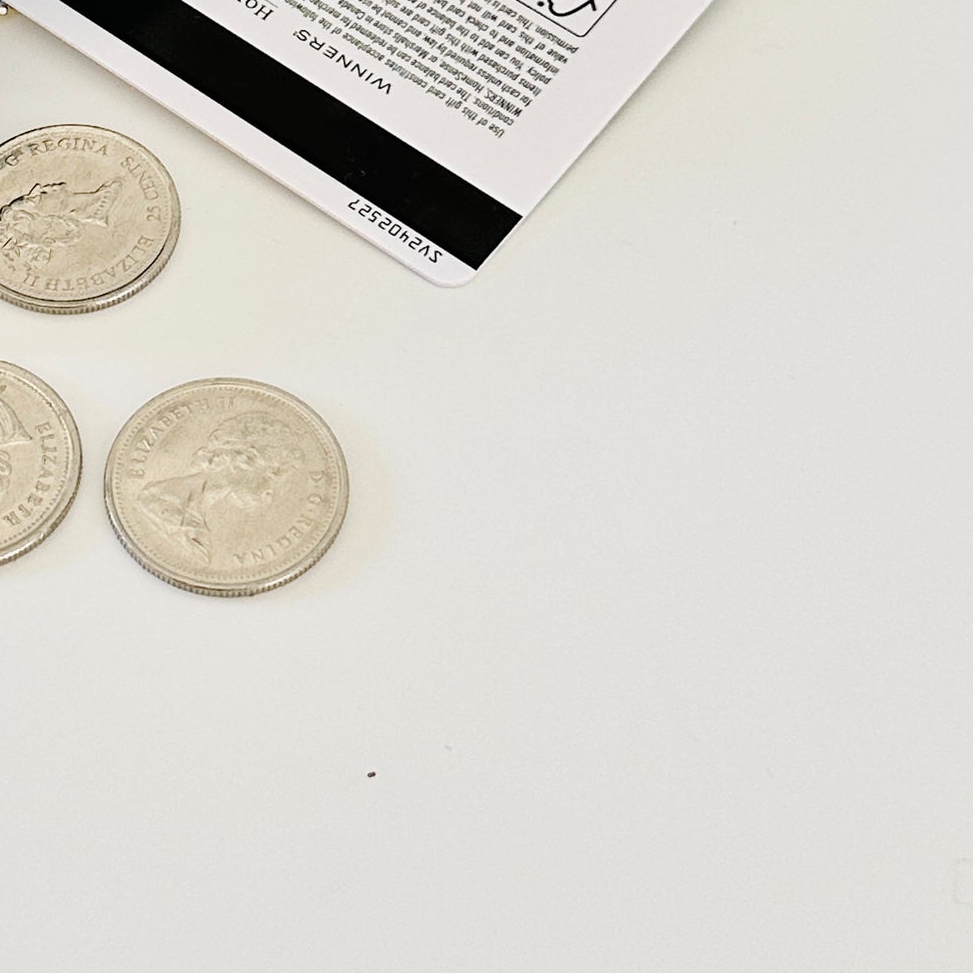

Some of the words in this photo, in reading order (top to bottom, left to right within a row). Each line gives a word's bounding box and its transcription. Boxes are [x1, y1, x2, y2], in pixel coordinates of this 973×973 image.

[370, 3, 384, 16] be
[398, 5, 415, 17] are
[414, 0, 428, 10] of
[445, 4, 467, 18] card
[466, 0, 484, 13] not
[490, 0, 502, 10] is
[496, 3, 519, 19] card
[317, 17, 333, 31] the
[339, 15, 353, 28] for
[364, 14, 375, 25] in
[380, 9, 409, 29] cannot
[410, 13, 432, 28] card
[425, 6, 458, 30] balance
[464, 15, 490, 32] check
[480, 9, 499, 23] will
[515, 14, 535, 31] This
[329, 26, 343, 35] of
[348, 21, 389, 48] redeemed
[372, 19, 395, 36] store
[403, 24, 423, 38] and
[428, 23, 448, 37] gift
[455, 24, 471, 38] the
[488, 28, 500, 40] to
[496, 19, 519, 34] card
[391, 31, 431, 60] Marshalls
[444, 32, 462, 48] this
[469, 32, 481, 44] to
[476, 38, 496, 51] add
[496, 34, 516, 48] and
[517, 30, 536, 46] this
[532, 41, 547, 51] of
[341, 32, 386, 62] acceptance
[385, 43, 399, 56] be
[435, 42, 449, 56] by
[460, 42, 480, 58] with
[493, 47, 511, 61] can
[293, 29, 392, 96] WINNERS
[395, 50, 413, 63] can
[427, 54, 439, 64] or
[443, 49, 479, 72] required
[508, 56, 525, 72] You
[514, 44, 561, 77] information
[546, 48, 569, 65] value
[409, 58, 442, 83] balance
[475, 53, 521, 82] purchased
[436, 76, 459, 91] card
[475, 68, 504, 88] unless
[425, 84, 447, 100] card
[455, 86, 473, 103] The
[500, 82, 522, 99] cash
[517, 77, 543, 98] Items
[444, 96, 464, 110] gift
[518, 94, 533, 108] for
[460, 106, 479, 122] this
[475, 117, 489, 127] of
[487, 122, 506, 139] Use
[120, 156, 160, 202] CENTS
[146, 205, 162, 223] 25
[347, 198, 444, 264] SV2402527
[44, 234, 156, 293] ELIZABETH
[2, 422, 59, 531] ELIZABETH
